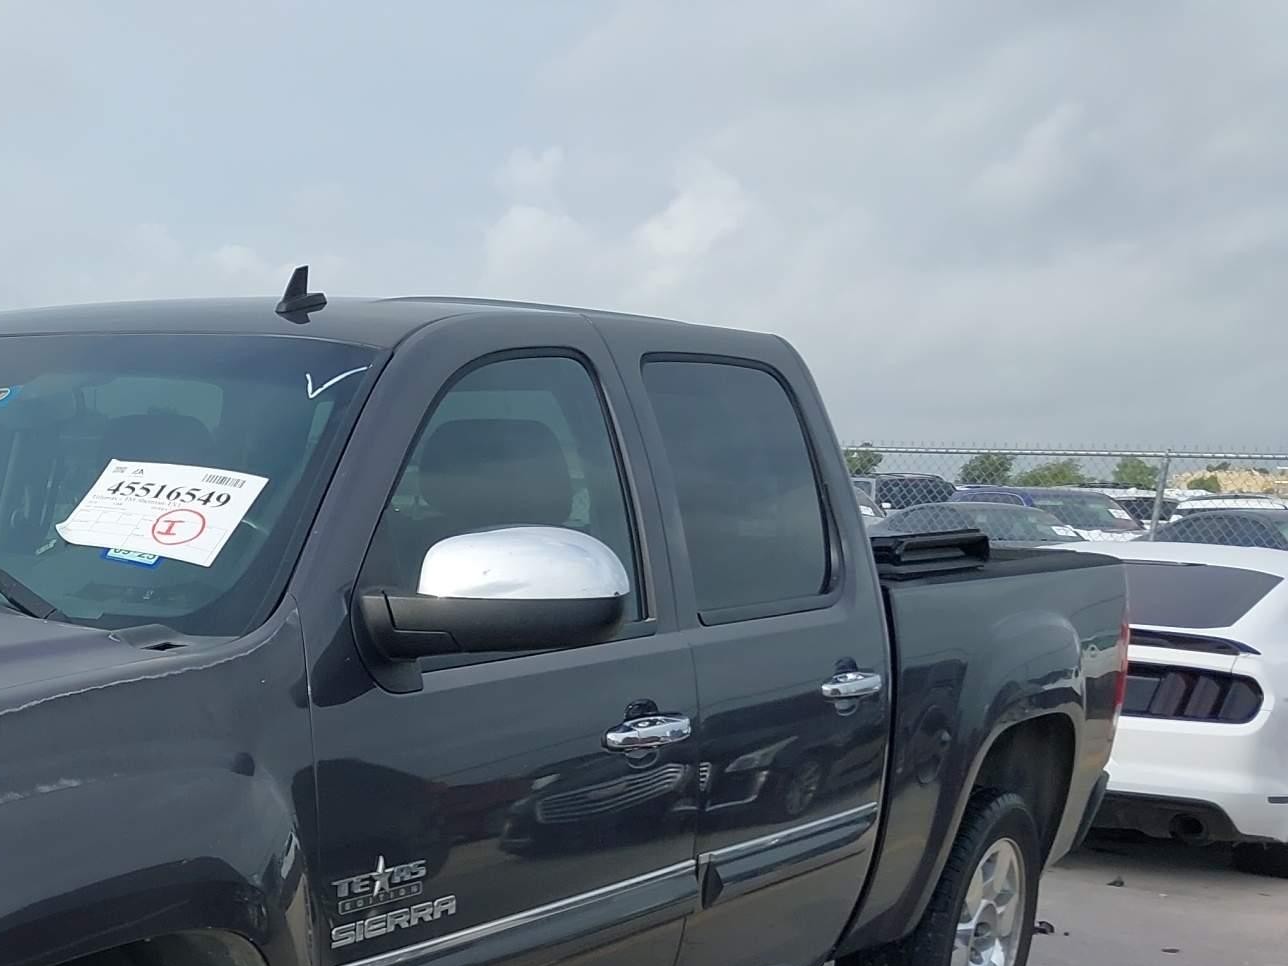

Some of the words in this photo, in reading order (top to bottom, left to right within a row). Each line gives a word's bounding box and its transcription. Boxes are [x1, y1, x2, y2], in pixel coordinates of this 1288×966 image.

[106, 480, 232, 508] 45516549
[330, 858, 427, 898] TEXAS
[342, 884, 419, 912] EDITION
[331, 894, 458, 949] SIERRA
